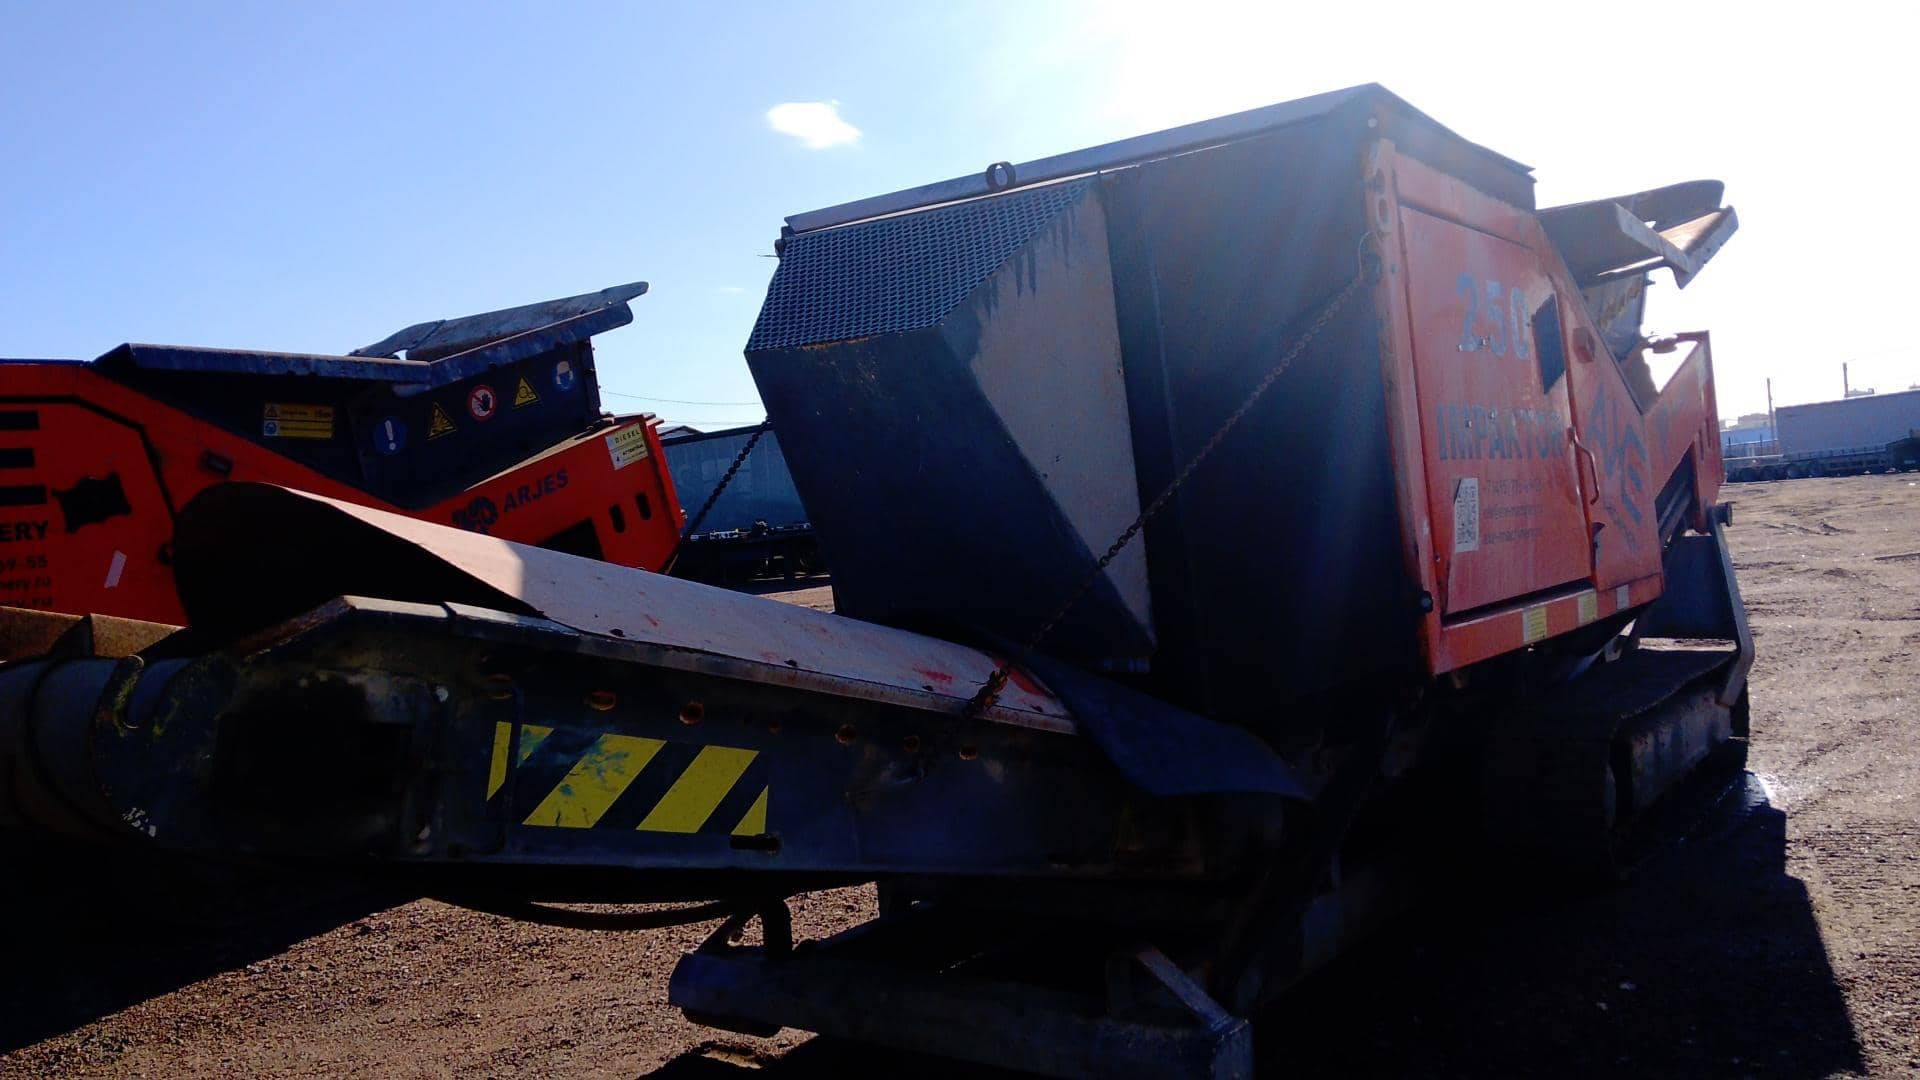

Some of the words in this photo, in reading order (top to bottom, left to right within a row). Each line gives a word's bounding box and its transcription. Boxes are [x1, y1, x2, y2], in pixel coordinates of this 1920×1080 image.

[1456, 273, 1531, 359] 250
[615, 430, 640, 443] DIESEL
[1438, 404, 1566, 459] IMPAKTOR
[504, 468, 570, 512] ARJES
